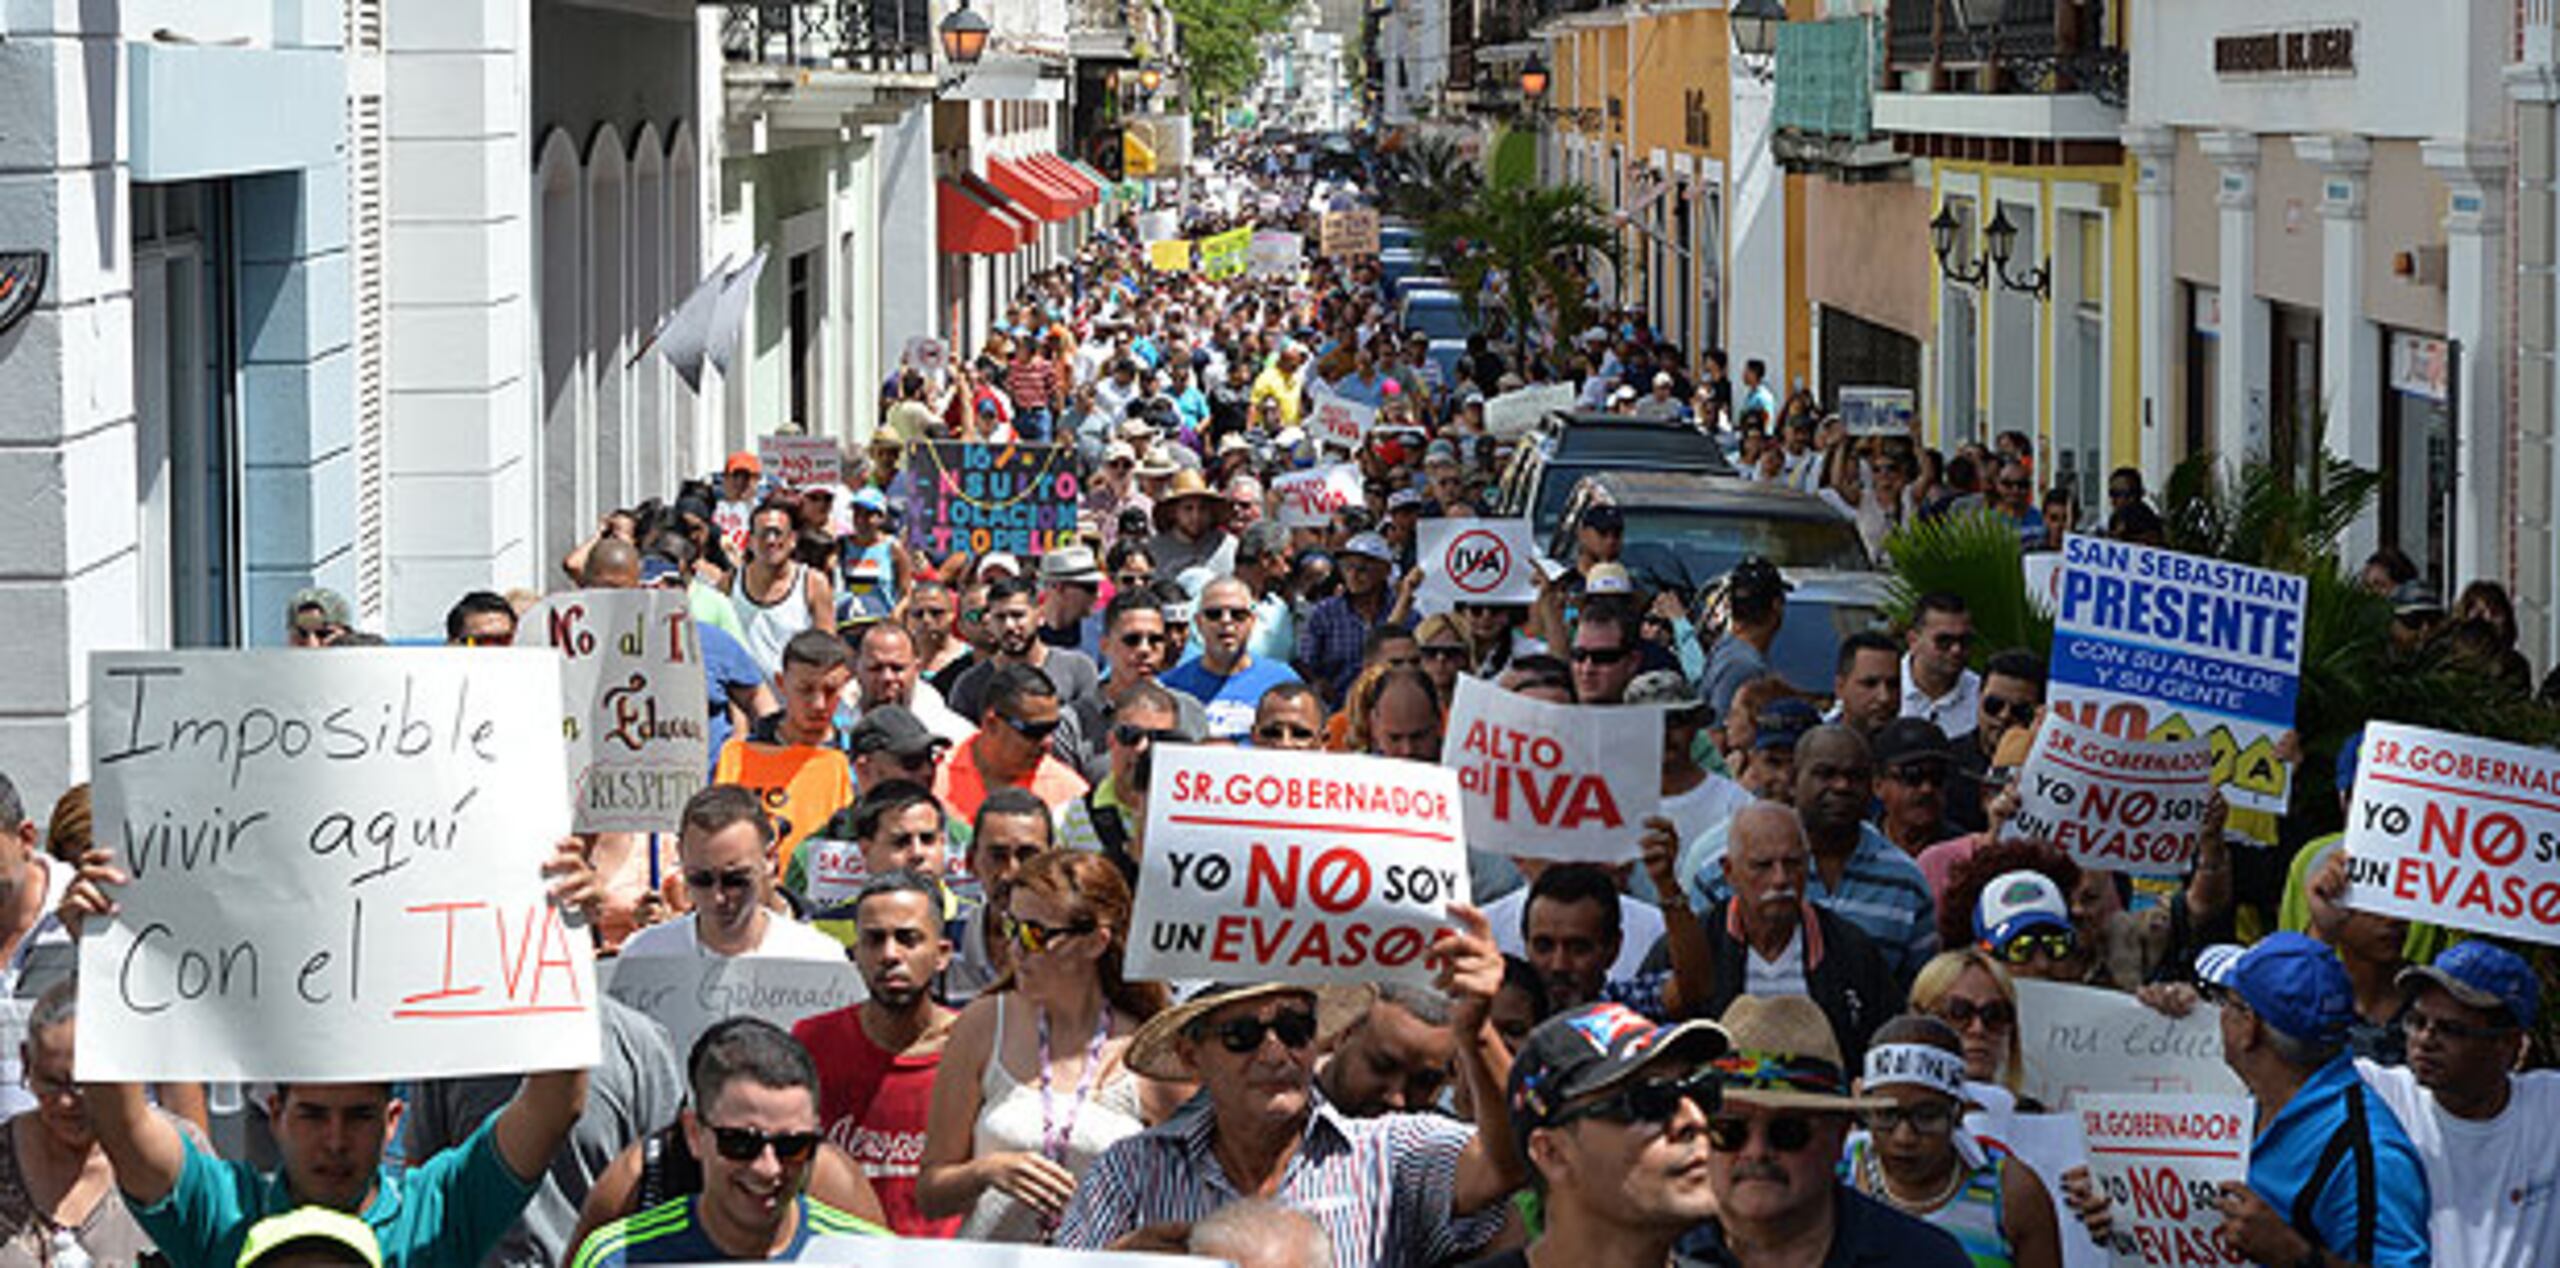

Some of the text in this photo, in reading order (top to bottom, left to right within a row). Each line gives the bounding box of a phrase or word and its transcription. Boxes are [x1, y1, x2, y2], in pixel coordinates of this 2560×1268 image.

[1454, 548, 1500, 573] IVA
[2066, 538, 2300, 604] SAN SEBASTIAN
[620, 613, 644, 656] al
[2062, 568, 2297, 663] PRESENTE
[2070, 638, 2285, 696] CON SU ALCALDE
[2095, 666, 2245, 709] Y SU GENTE
[100, 667, 499, 789] Imposible
[1464, 718, 1564, 770] ALTO
[1457, 761, 1626, 830] al IVA
[2035, 773, 2076, 805] YO
[2079, 783, 2159, 828] NO
[123, 787, 479, 886] vivir aquí
[2364, 800, 2560, 868] YO NO S
[1167, 843, 1458, 915] YO NO SOY
[119, 896, 582, 1015] Con el IVA
[1151, 921, 1206, 952] UN
[2126, 1166, 2189, 1223] NO
[2188, 1179, 2217, 1211] SO
